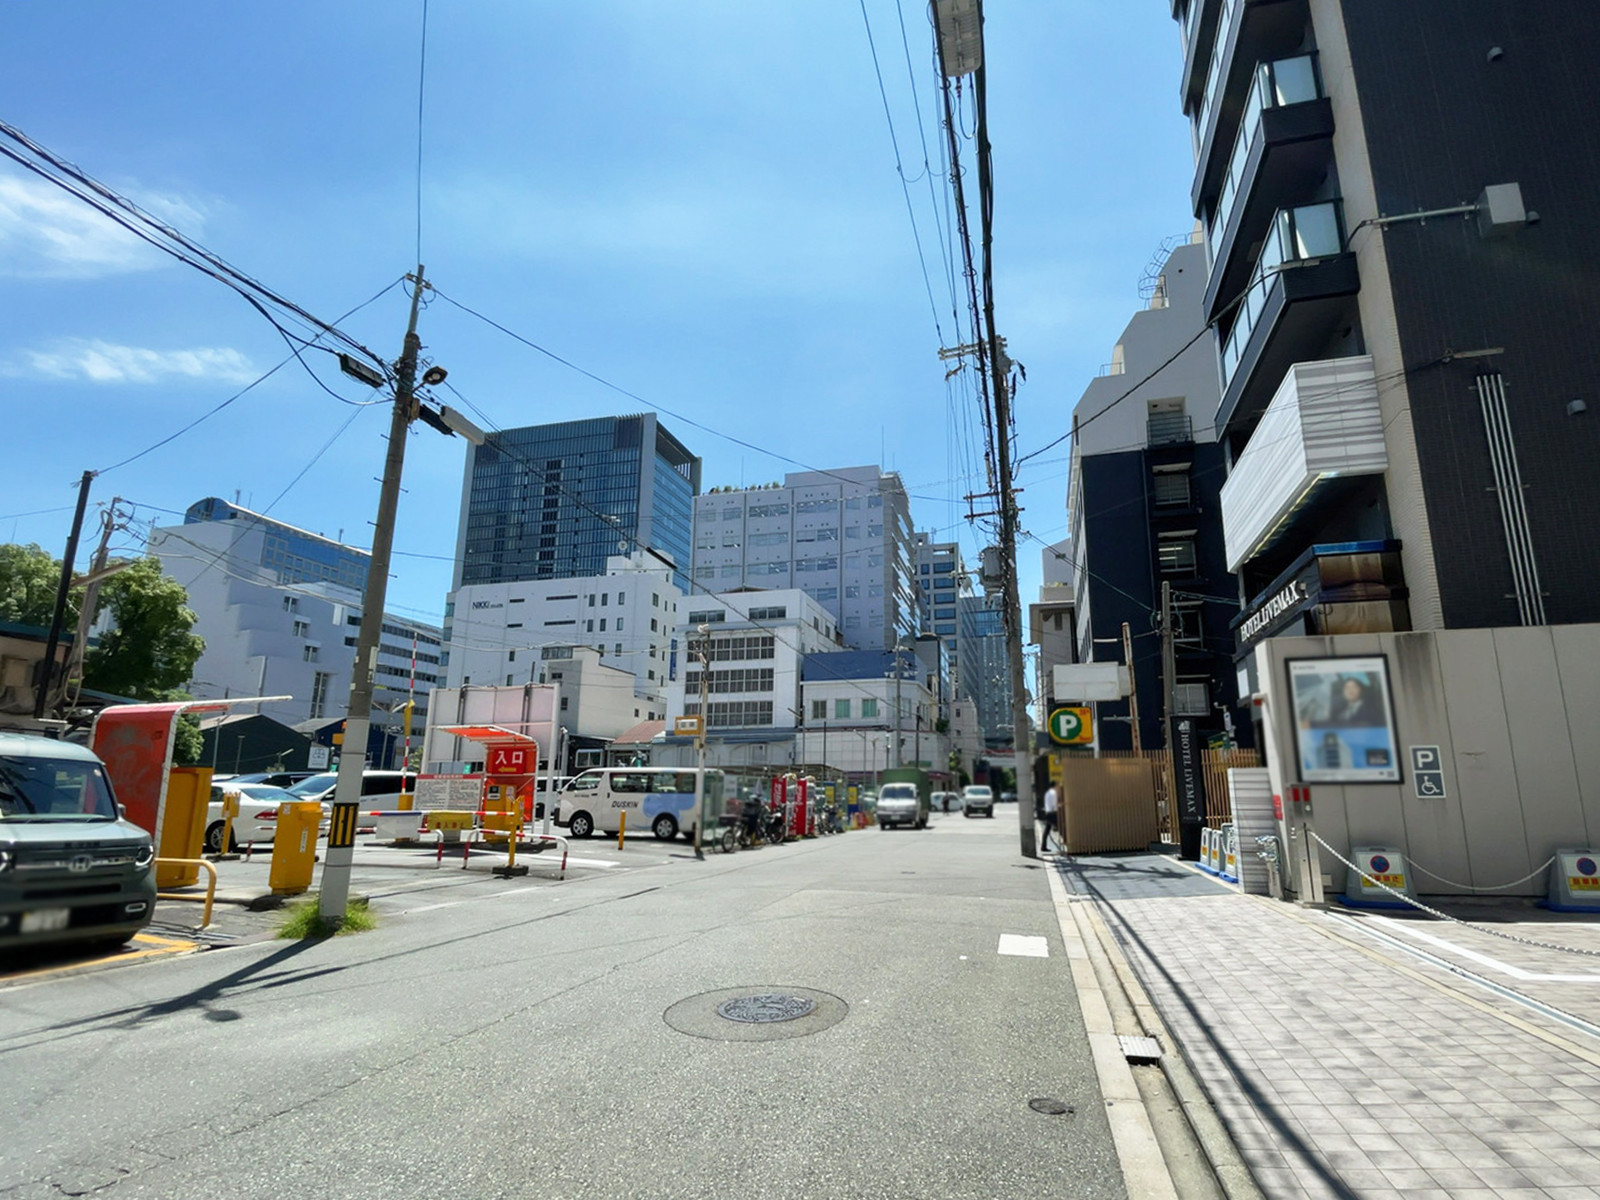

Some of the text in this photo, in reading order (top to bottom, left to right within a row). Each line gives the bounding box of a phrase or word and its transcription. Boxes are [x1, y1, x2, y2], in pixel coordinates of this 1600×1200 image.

[1240, 611, 1262, 642] HOTEL
[1059, 714, 1078, 738] P
[495, 750, 523, 765] 入口
[1181, 734, 1192, 767] HOTEL
[1416, 750, 1434, 768] P
[612, 800, 639, 808] DUSKIN
